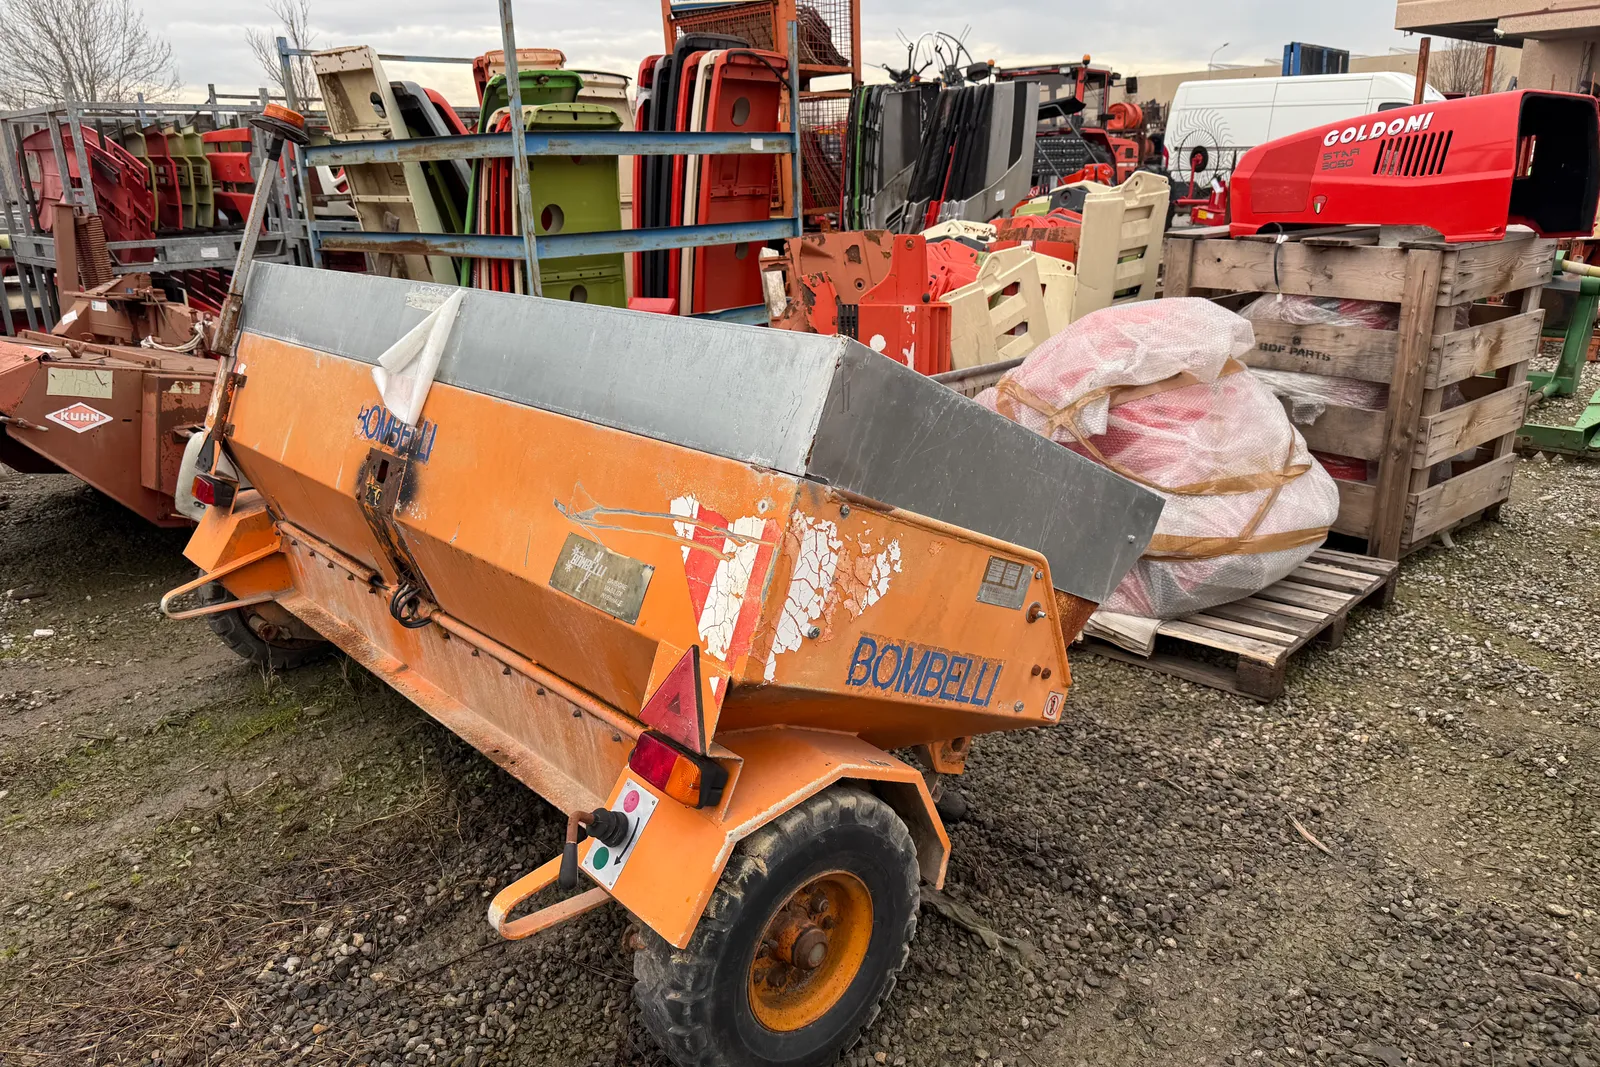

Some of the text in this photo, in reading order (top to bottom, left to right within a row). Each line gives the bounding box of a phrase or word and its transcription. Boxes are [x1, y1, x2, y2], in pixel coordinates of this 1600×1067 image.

[1323, 112, 1434, 147] GOLDONI
[1323, 148, 1360, 161] STAR
[1322, 159, 1354, 171] 3050
[1289, 347, 1331, 362] PARTS
[60, 410, 101, 423] KUHN
[570, 552, 608, 578] BOMBELLI
[845, 635, 1003, 708] BOMBELLI
